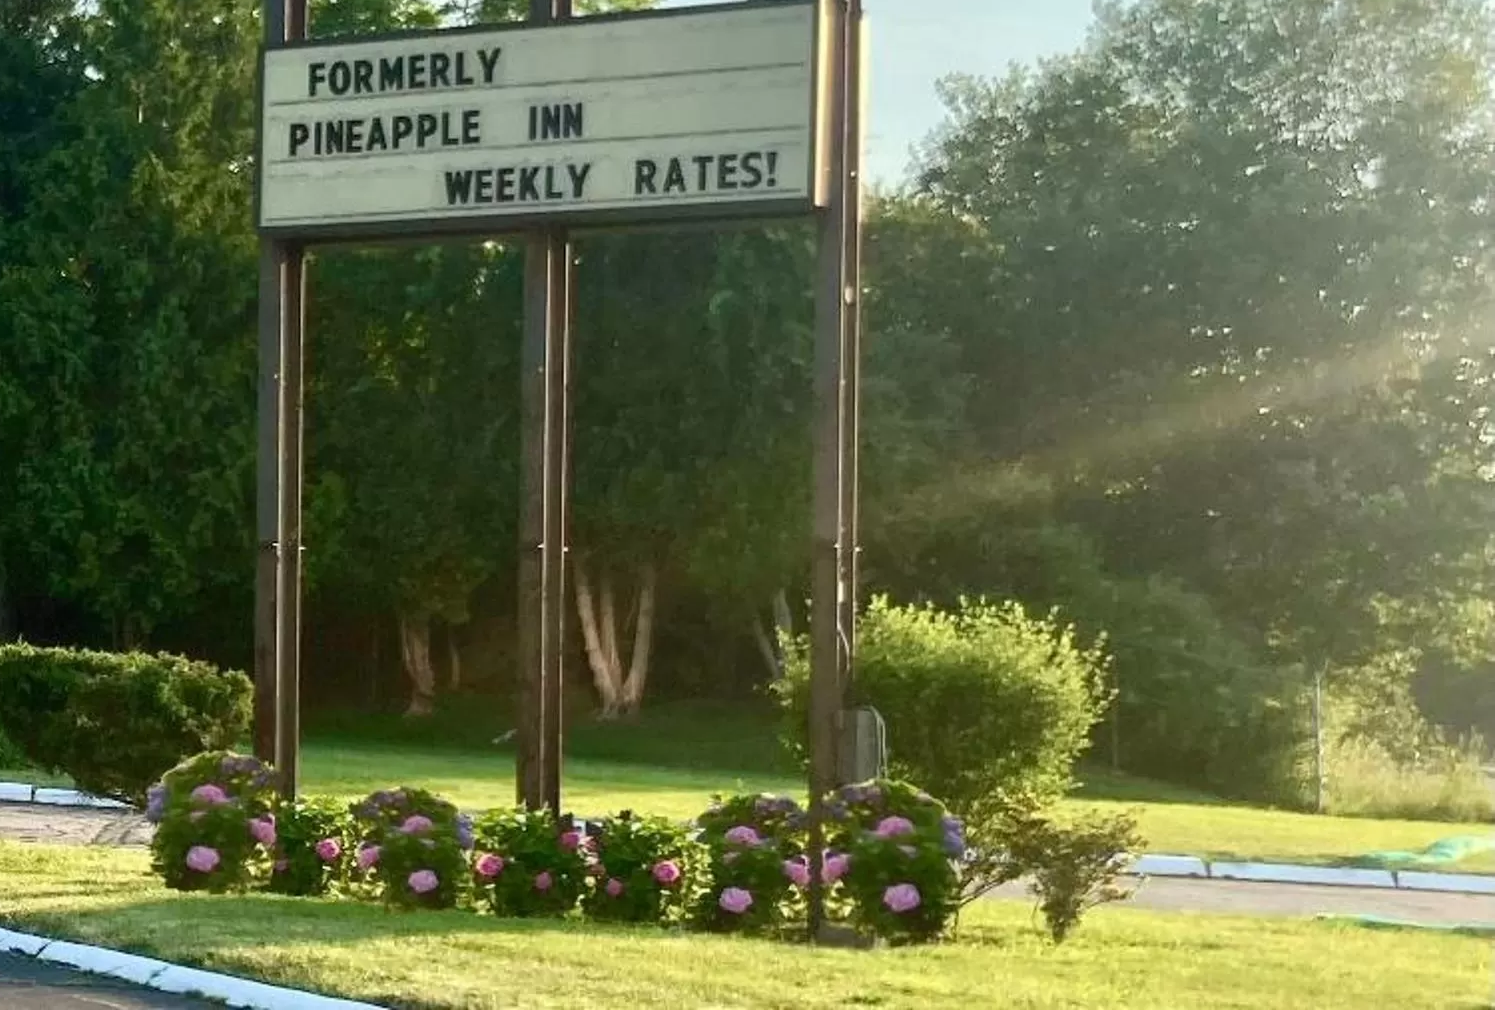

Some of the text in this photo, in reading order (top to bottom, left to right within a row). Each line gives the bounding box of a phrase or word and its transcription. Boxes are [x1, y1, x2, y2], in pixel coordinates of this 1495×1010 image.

[308, 47, 502, 97] FORMERLY
[288, 102, 583, 157] PINEAPPLE INN
[444, 150, 779, 205] WEEKLY RATES!
